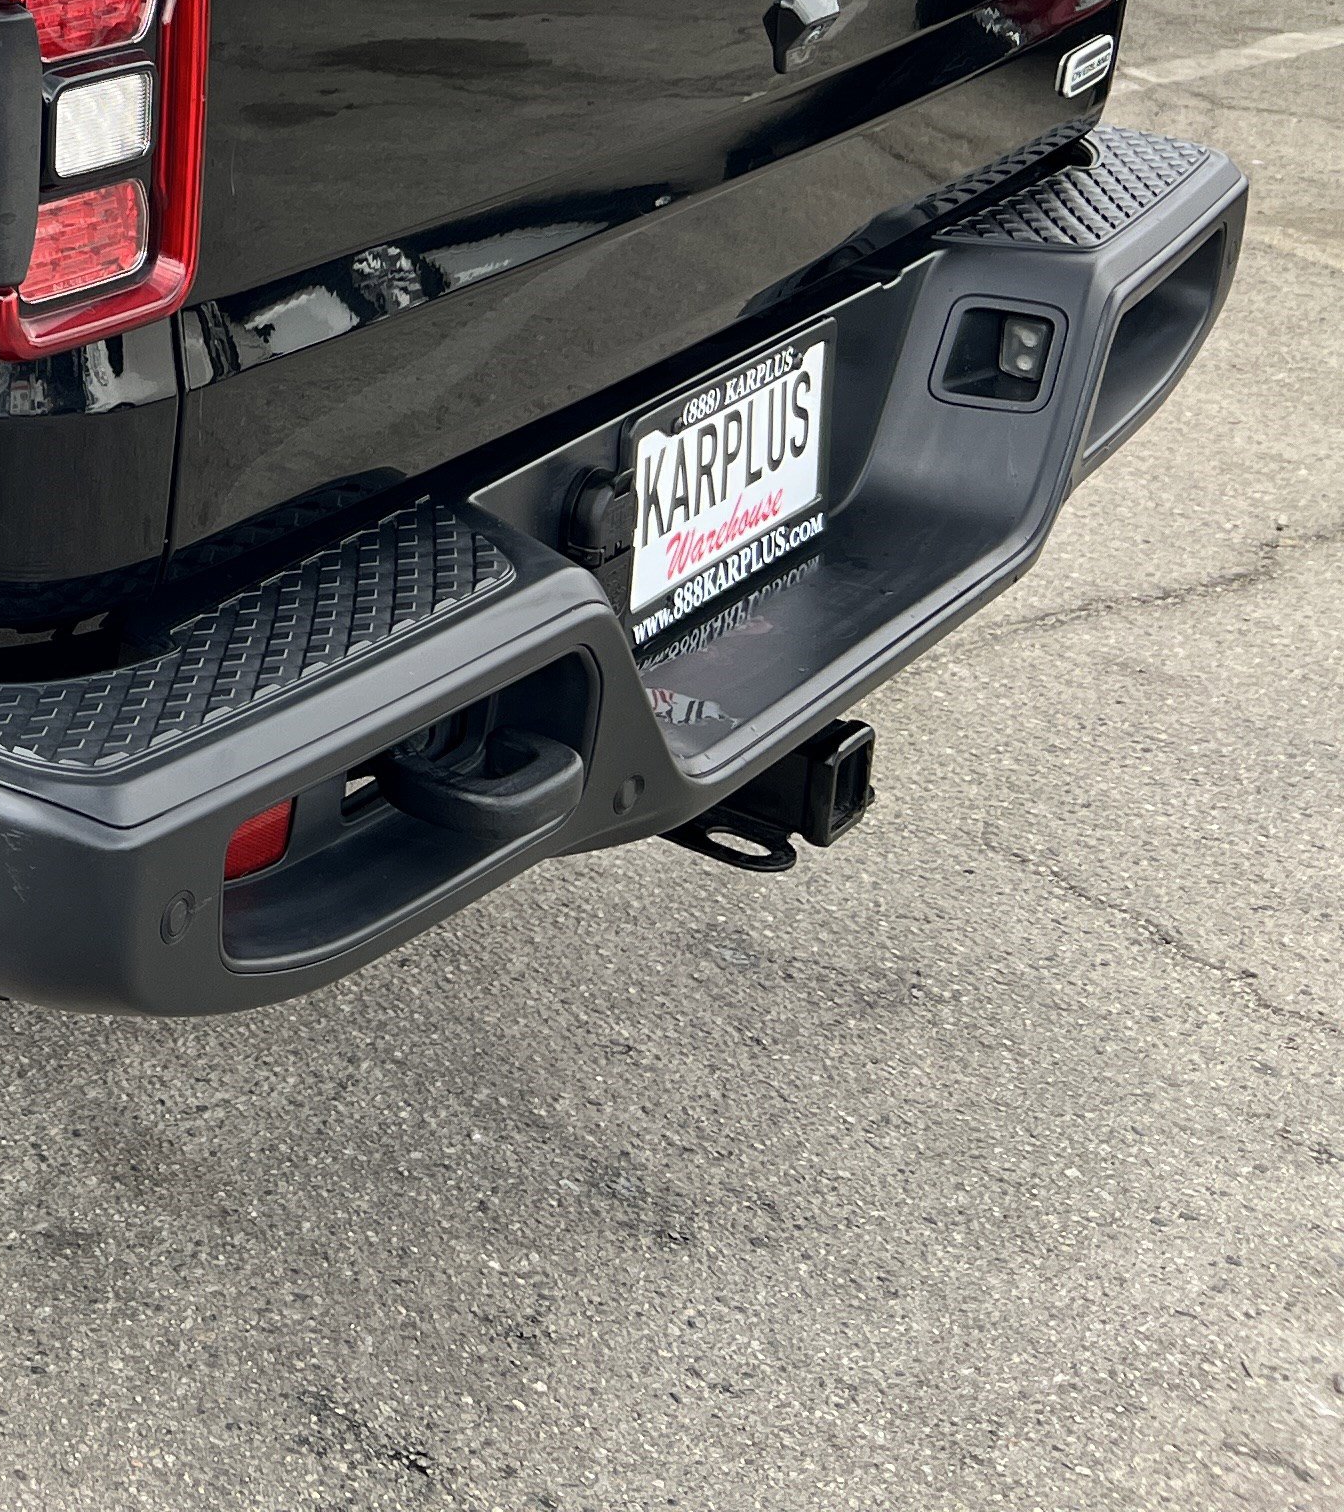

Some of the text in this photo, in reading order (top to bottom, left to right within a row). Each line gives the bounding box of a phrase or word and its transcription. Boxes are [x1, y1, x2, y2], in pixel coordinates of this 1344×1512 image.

[682, 345, 795, 425] (888) KARPLUS
[640, 370, 812, 549] KARPLUS
[665, 488, 785, 581] Warehouse
